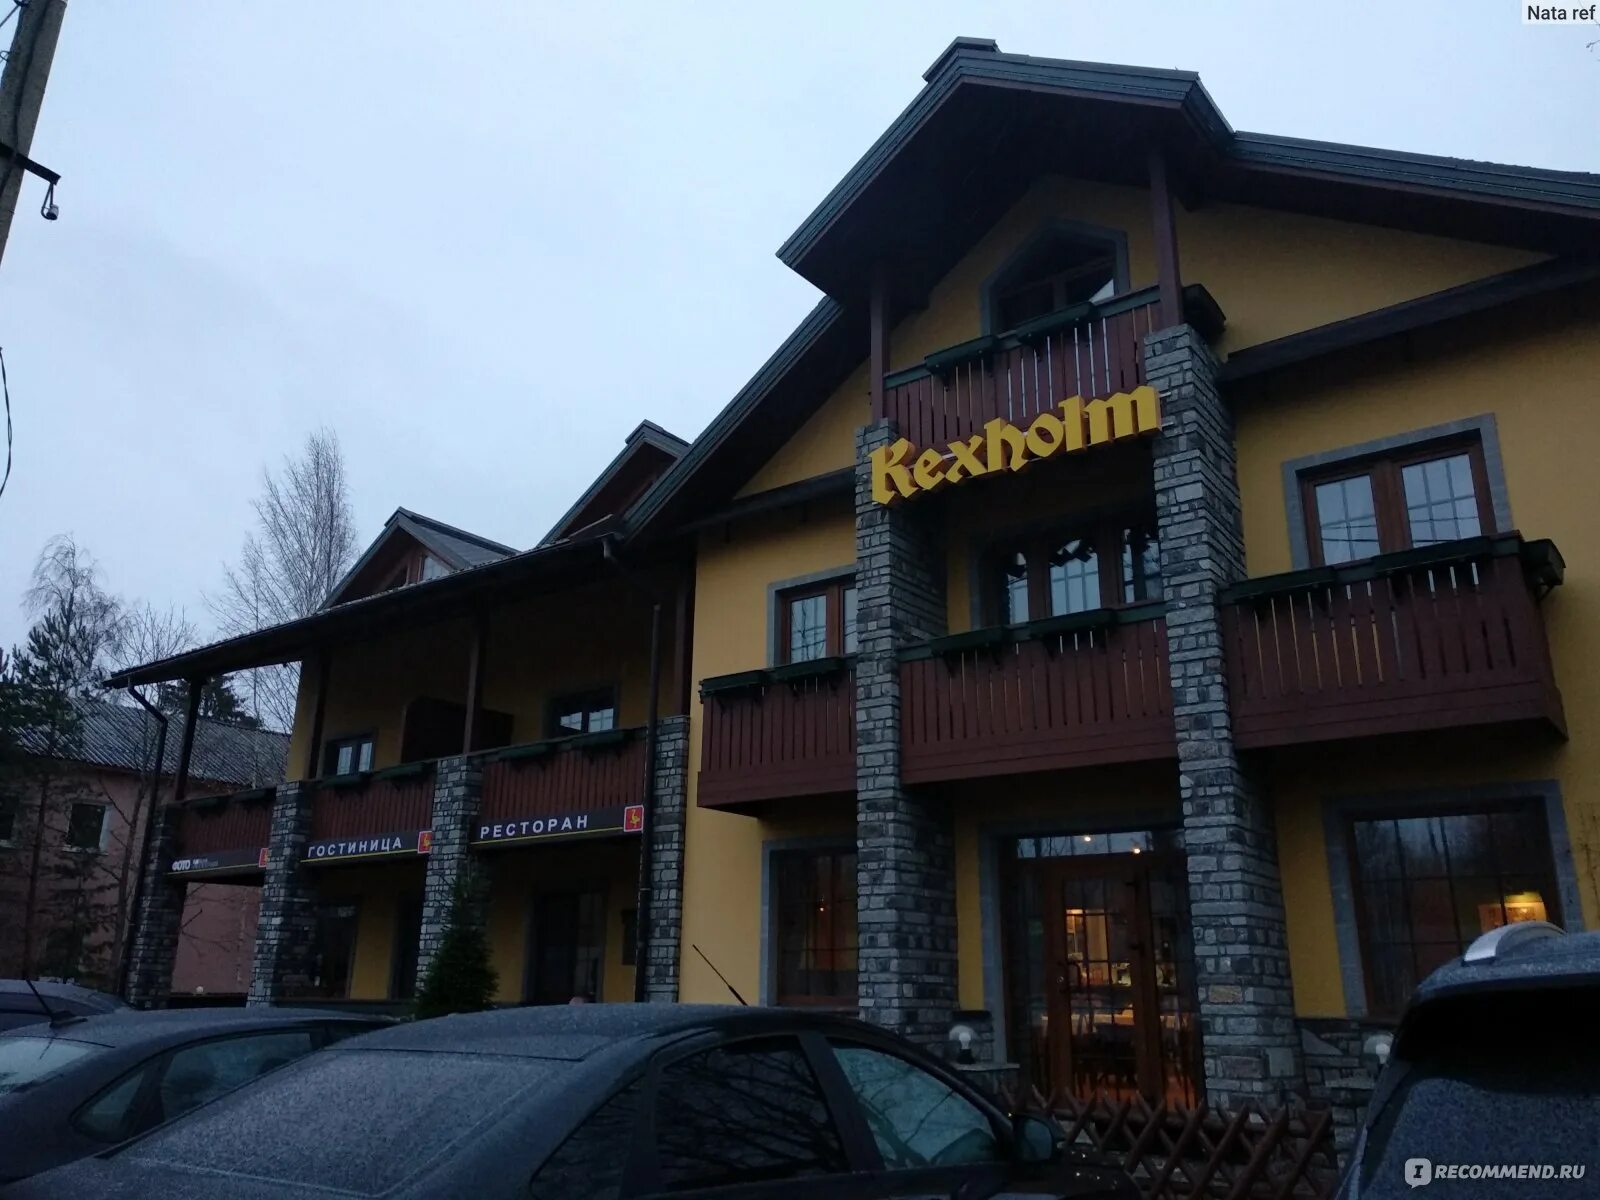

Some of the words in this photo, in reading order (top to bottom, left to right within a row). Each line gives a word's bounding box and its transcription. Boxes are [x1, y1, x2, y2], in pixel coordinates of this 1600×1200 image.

[868, 386, 1162, 505] Kexholm
[479, 815, 588, 839] РЕСТОРАН
[307, 836, 402, 858] ГОСТИНИЦА
